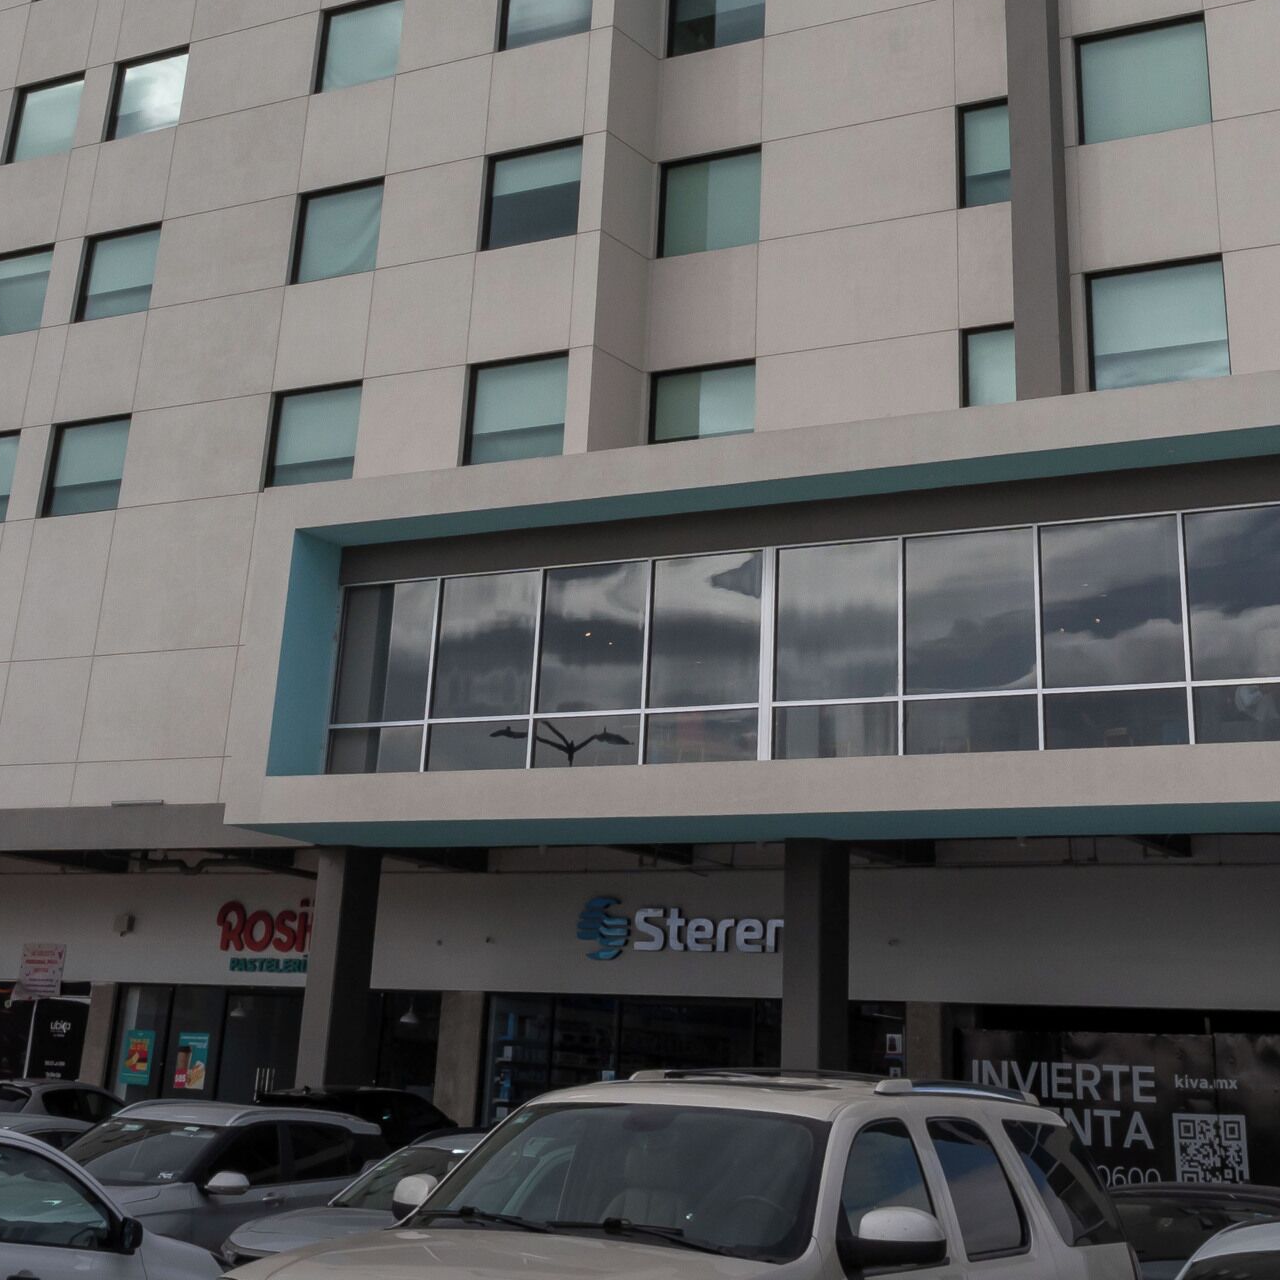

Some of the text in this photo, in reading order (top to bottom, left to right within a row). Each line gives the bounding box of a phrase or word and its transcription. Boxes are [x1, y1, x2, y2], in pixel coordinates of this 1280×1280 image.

[971, 1060, 1157, 1103] INVIERTE
[1174, 1074, 1238, 1090] kiva.mx
[1052, 1107, 1155, 1149] NTA
